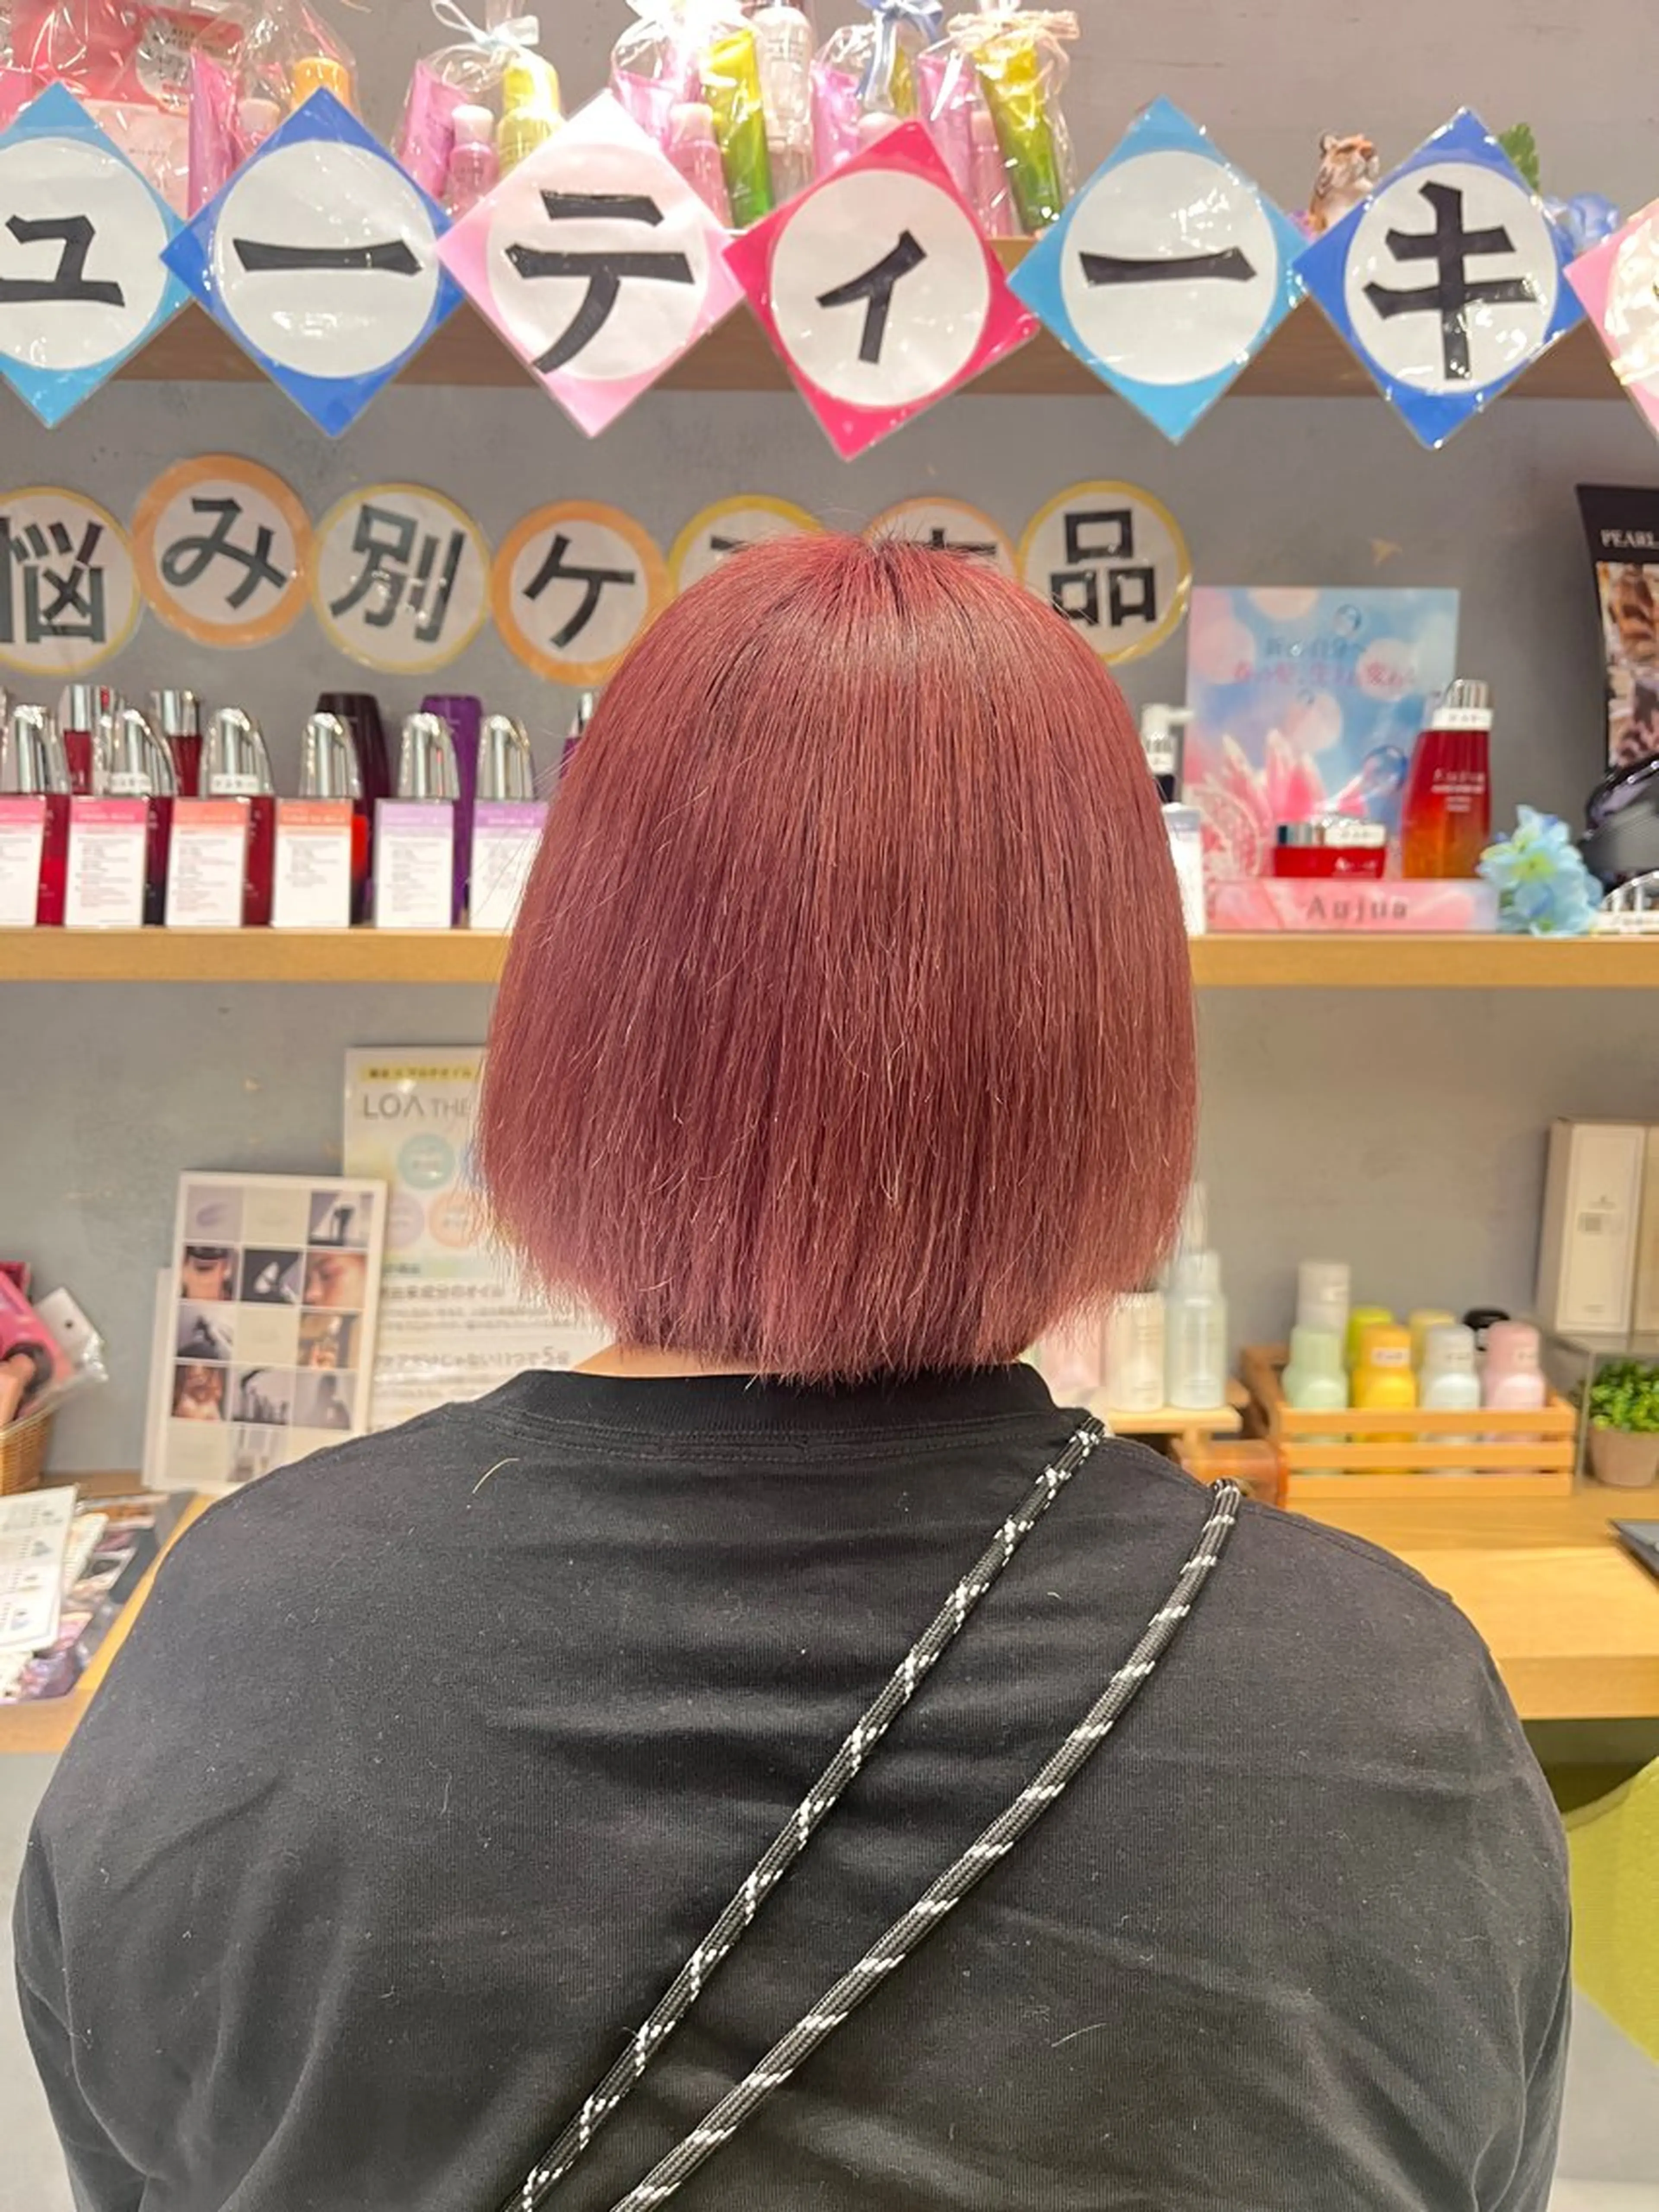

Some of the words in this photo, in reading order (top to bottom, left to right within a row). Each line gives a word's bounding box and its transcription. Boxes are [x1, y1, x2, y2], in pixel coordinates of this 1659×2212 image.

[0, 497, 1157, 649] 悩み別ケ品
